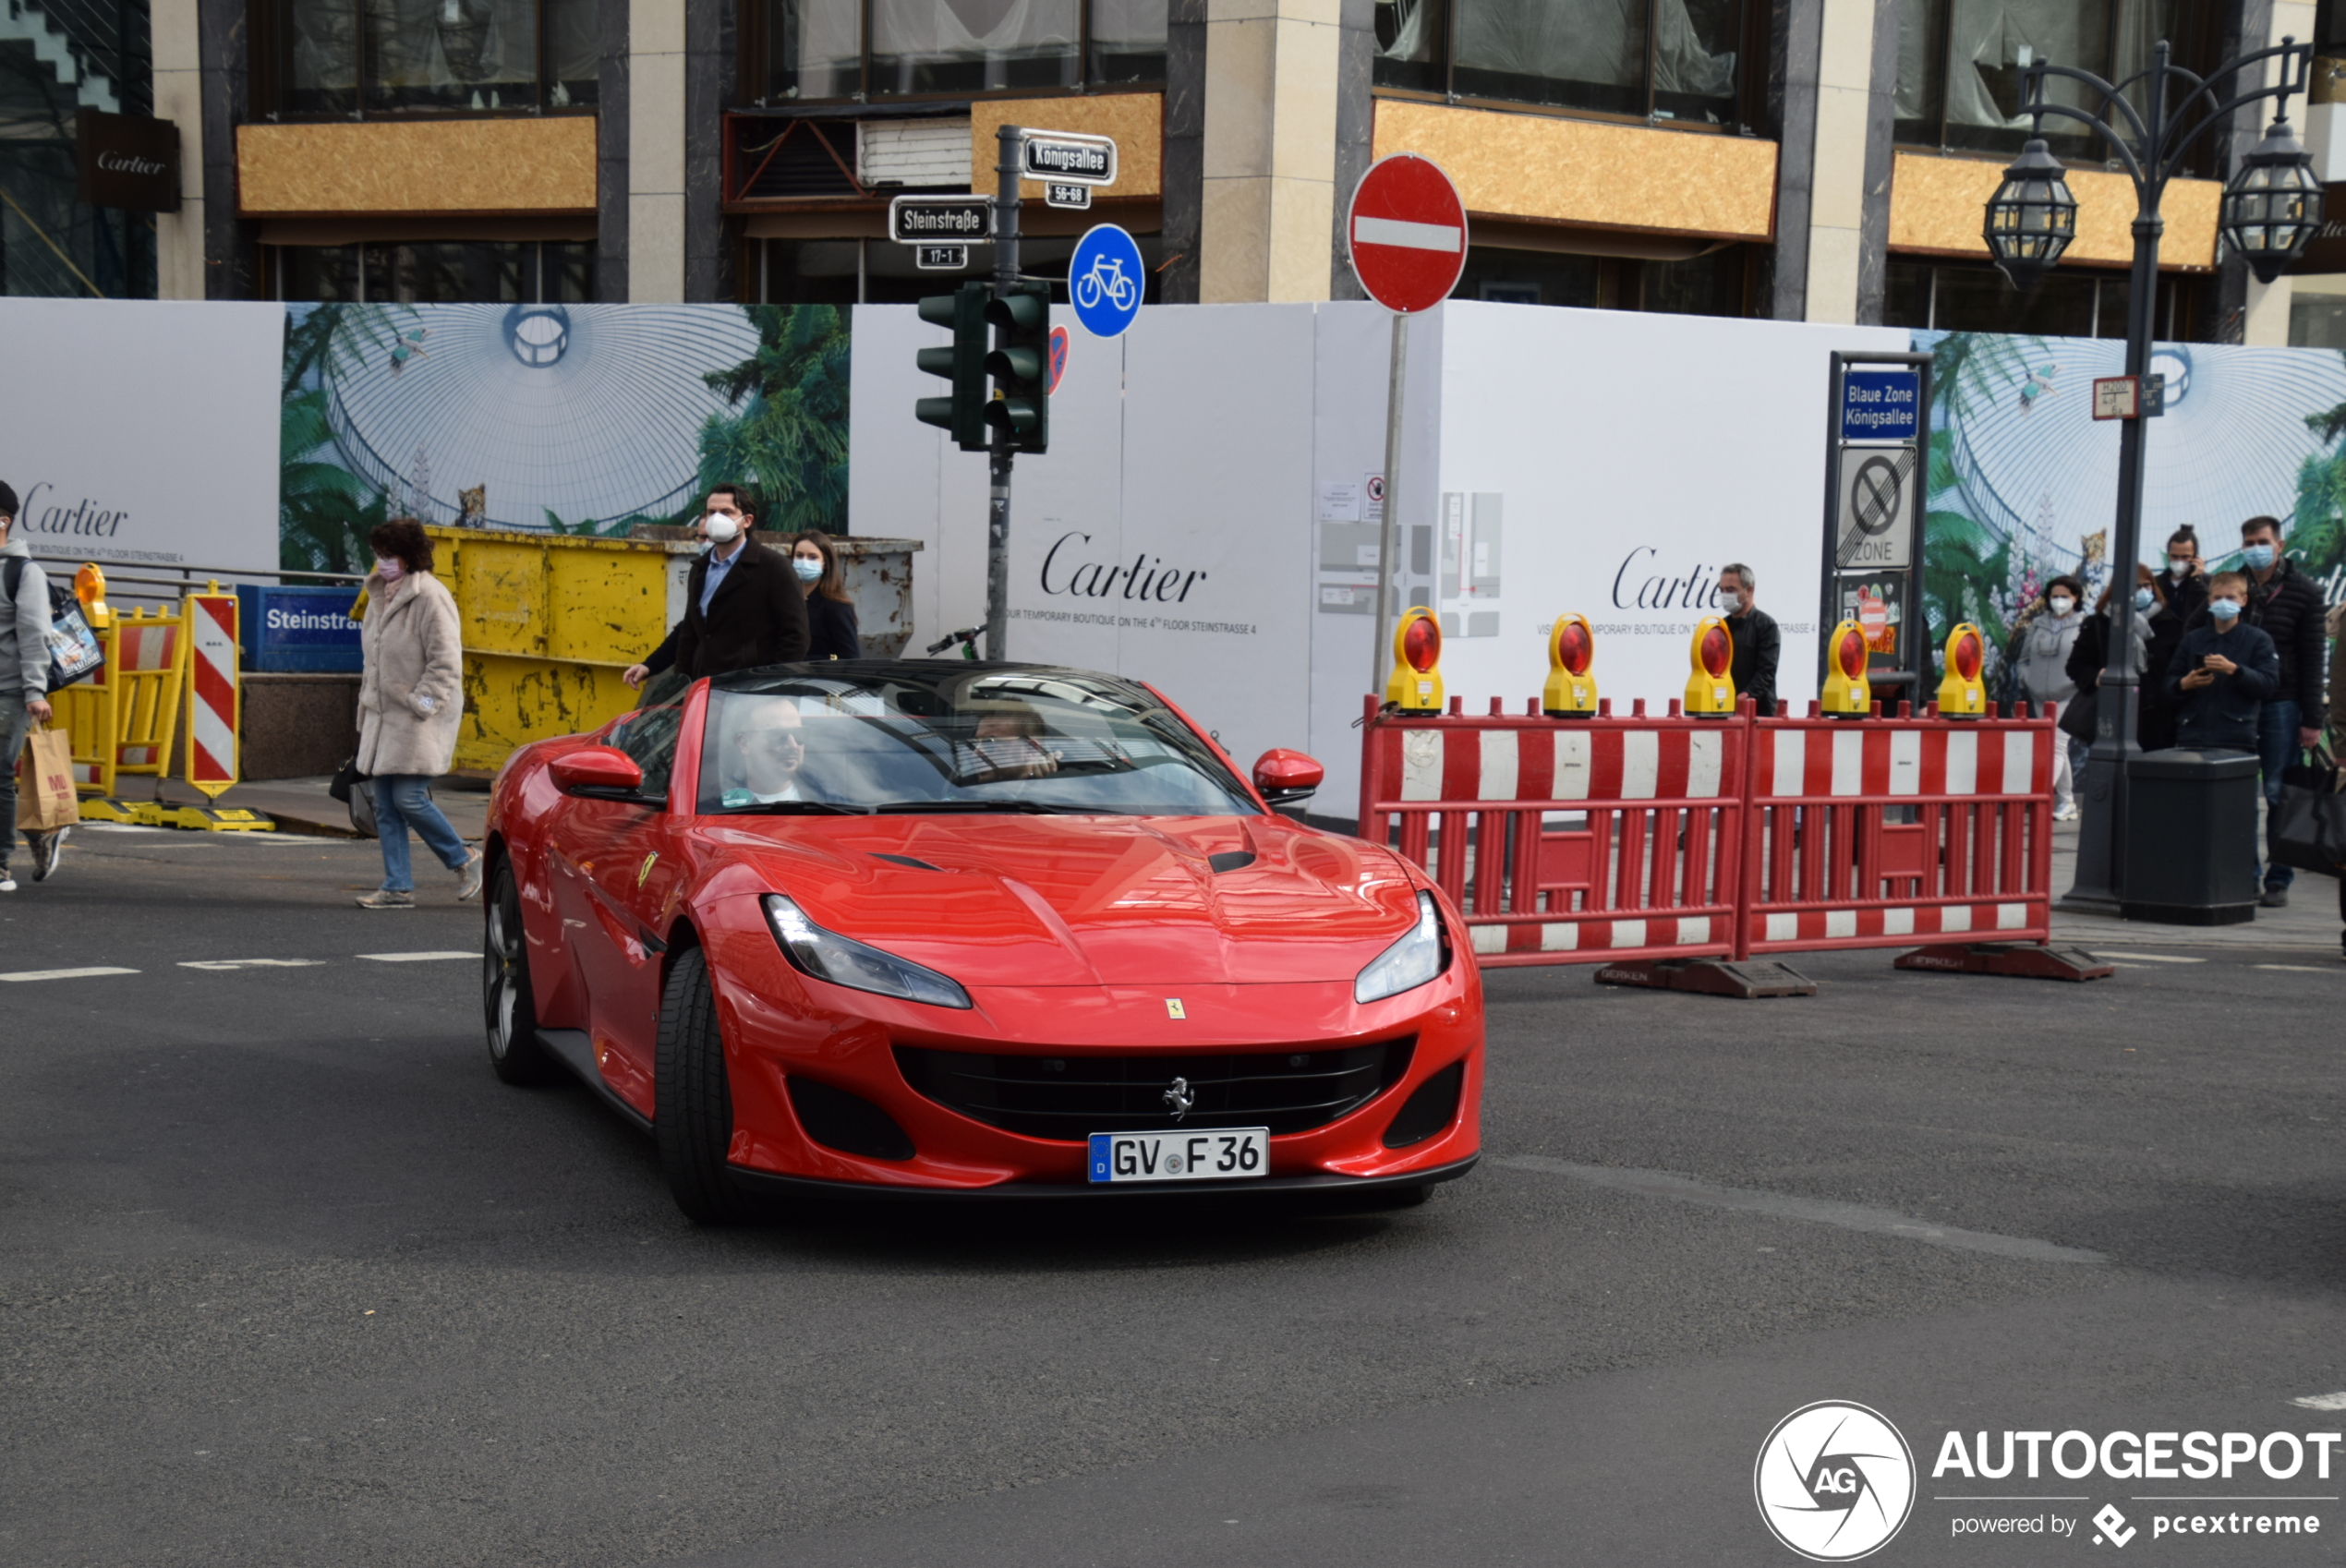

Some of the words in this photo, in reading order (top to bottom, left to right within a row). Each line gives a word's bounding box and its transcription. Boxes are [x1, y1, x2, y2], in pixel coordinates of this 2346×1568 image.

[98, 150, 165, 175] Cartier
[1035, 143, 1105, 170] Königsallee
[1055, 187, 1083, 202] 56-68
[904, 210, 980, 232] Steinstraße
[930, 249, 953, 263] 17-1
[1849, 385, 1881, 403] Blaue
[1884, 385, 1913, 403] Zone
[1846, 408, 1914, 429] Königsallee
[21, 481, 127, 537] Cartier
[1855, 541, 1893, 561] ZONE
[1041, 531, 1207, 602] Cartier
[1613, 546, 1722, 609] Cartie
[267, 609, 362, 630] Steinstra
[1023, 610, 1071, 622] TEMPORARY
[1073, 613, 1115, 625] BOUTIQUE
[1119, 617, 1131, 627] ON
[1133, 618, 1148, 628] THE
[1163, 620, 1191, 631] FLOOR
[1191, 621, 1249, 634] STEINSTRASSE
[1251, 624, 1256, 634] 4
[1635, 624, 1676, 635] BOUTIQUE
[1678, 624, 1690, 633] ON
[1811, 624, 1816, 633] 4
[1602, 970, 1648, 982] GERKEN
[1114, 1140, 1161, 1175] GV
[1187, 1138, 1208, 1173] F
[1216, 1136, 1259, 1171] 36
[1096, 1163, 1106, 1174] D
